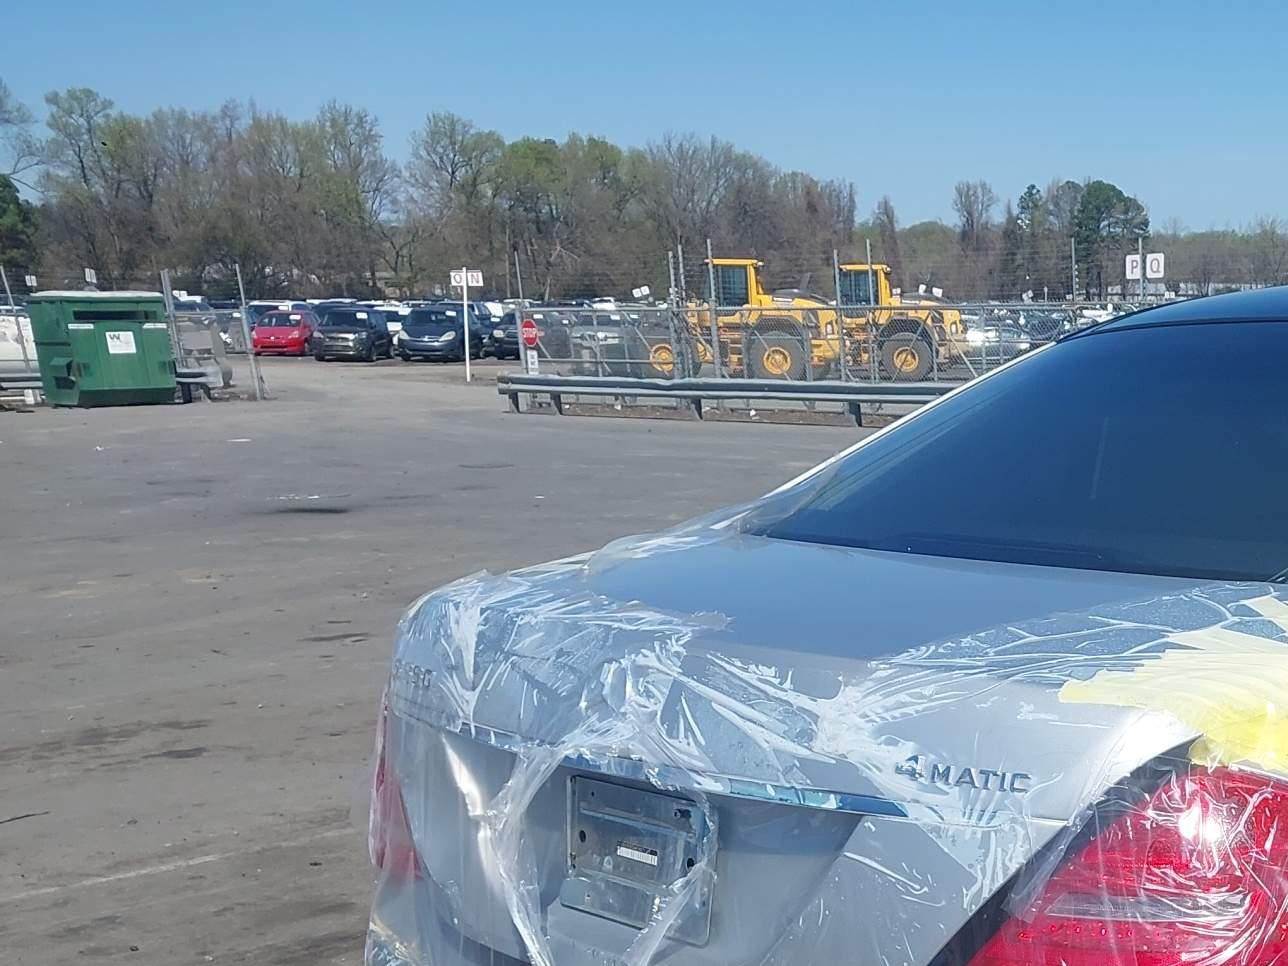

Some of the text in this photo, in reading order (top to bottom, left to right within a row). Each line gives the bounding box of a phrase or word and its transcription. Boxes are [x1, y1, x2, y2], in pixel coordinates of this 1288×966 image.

[1131, 259, 1139, 274] P
[1150, 258, 1161, 274] Q
[470, 273, 480, 284] N
[522, 327, 536, 338] STOP
